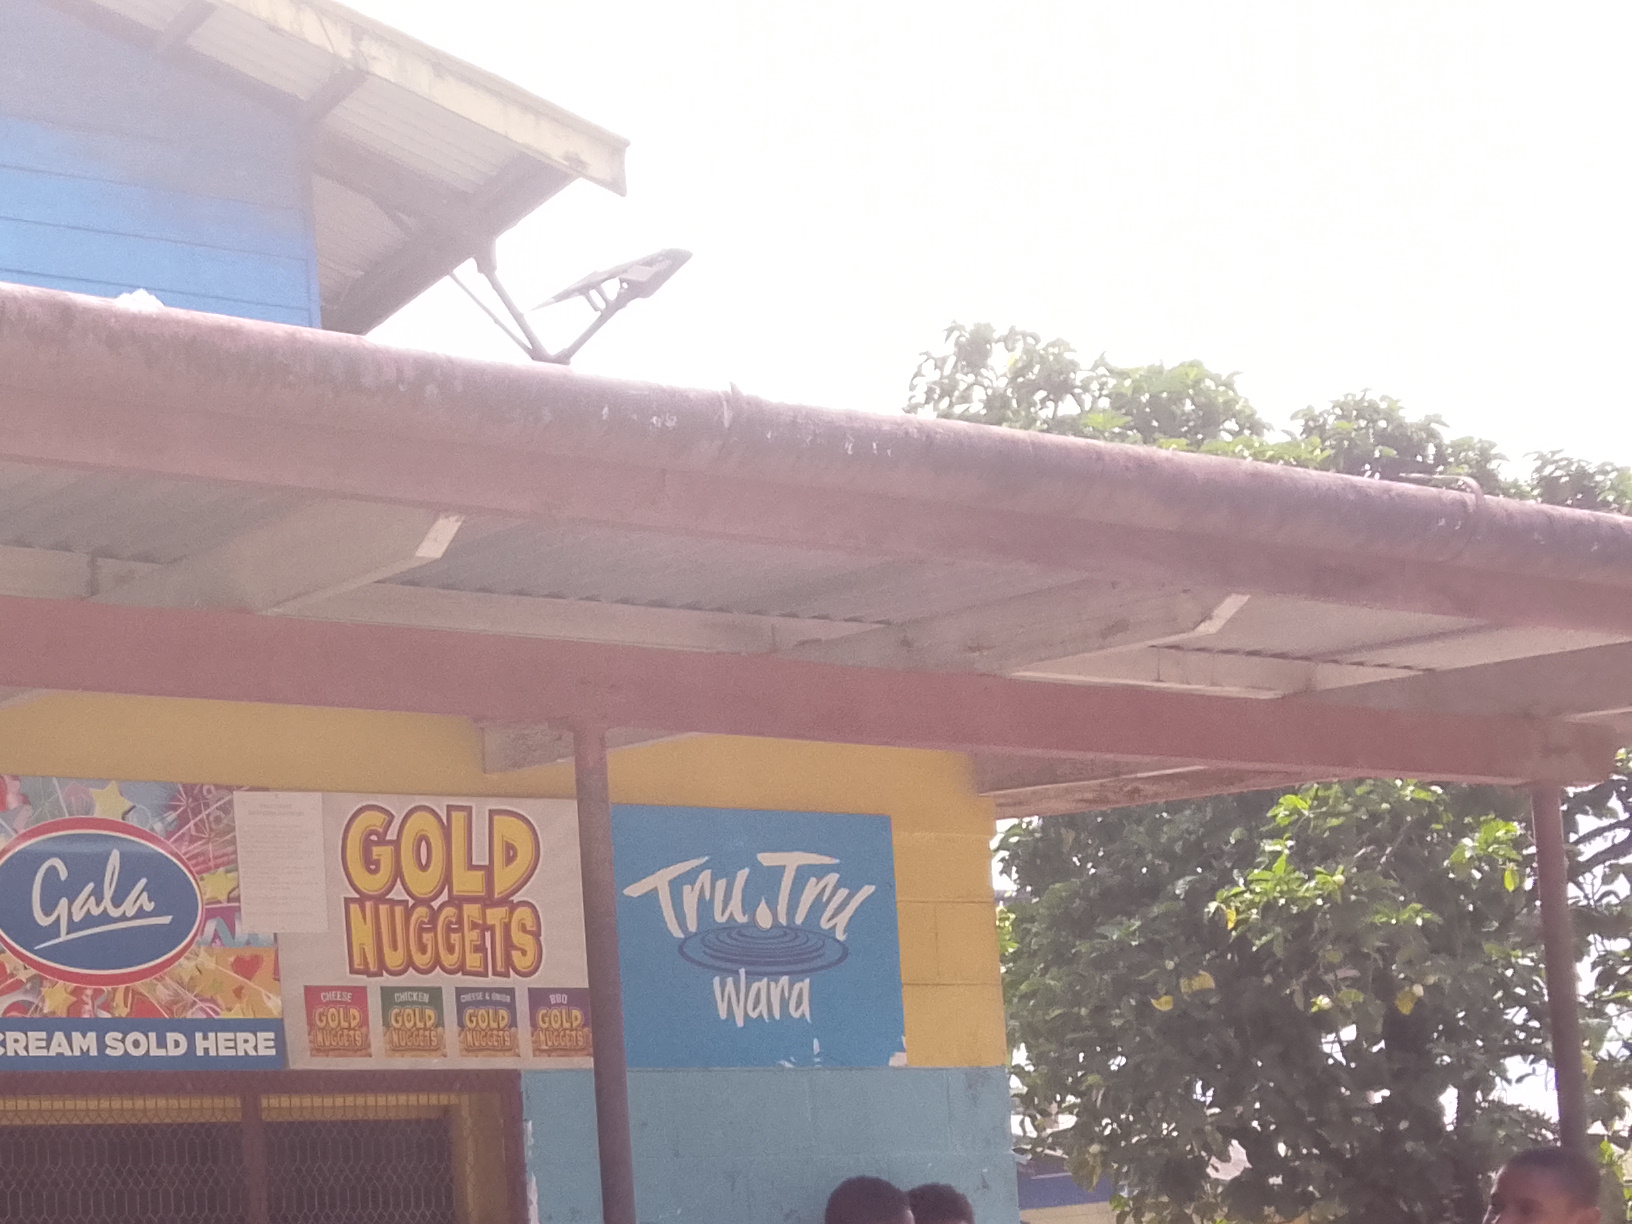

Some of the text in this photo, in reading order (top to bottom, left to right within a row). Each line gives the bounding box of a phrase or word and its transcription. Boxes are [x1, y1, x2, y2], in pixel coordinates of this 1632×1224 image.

[341, 804, 540, 900] GOLD
[31, 848, 174, 948] Gala
[622, 851, 876, 941] Tru Tru
[344, 897, 542, 978] NUGGETS
[320, 991, 353, 1003] CHEESE
[394, 991, 430, 1003] CHICKEN
[713, 967, 811, 1028] Wara
[314, 1006, 362, 1029] GOLD
[390, 1006, 437, 1030] GOLD
[465, 1007, 509, 1030] GOLD
[537, 1008, 582, 1030] GOLD
[105, 1031, 187, 1057] SOLD
[195, 1032, 276, 1056] HERE
[316, 1029, 363, 1048] NUGGETS
[391, 1029, 438, 1048] NUGGETS
